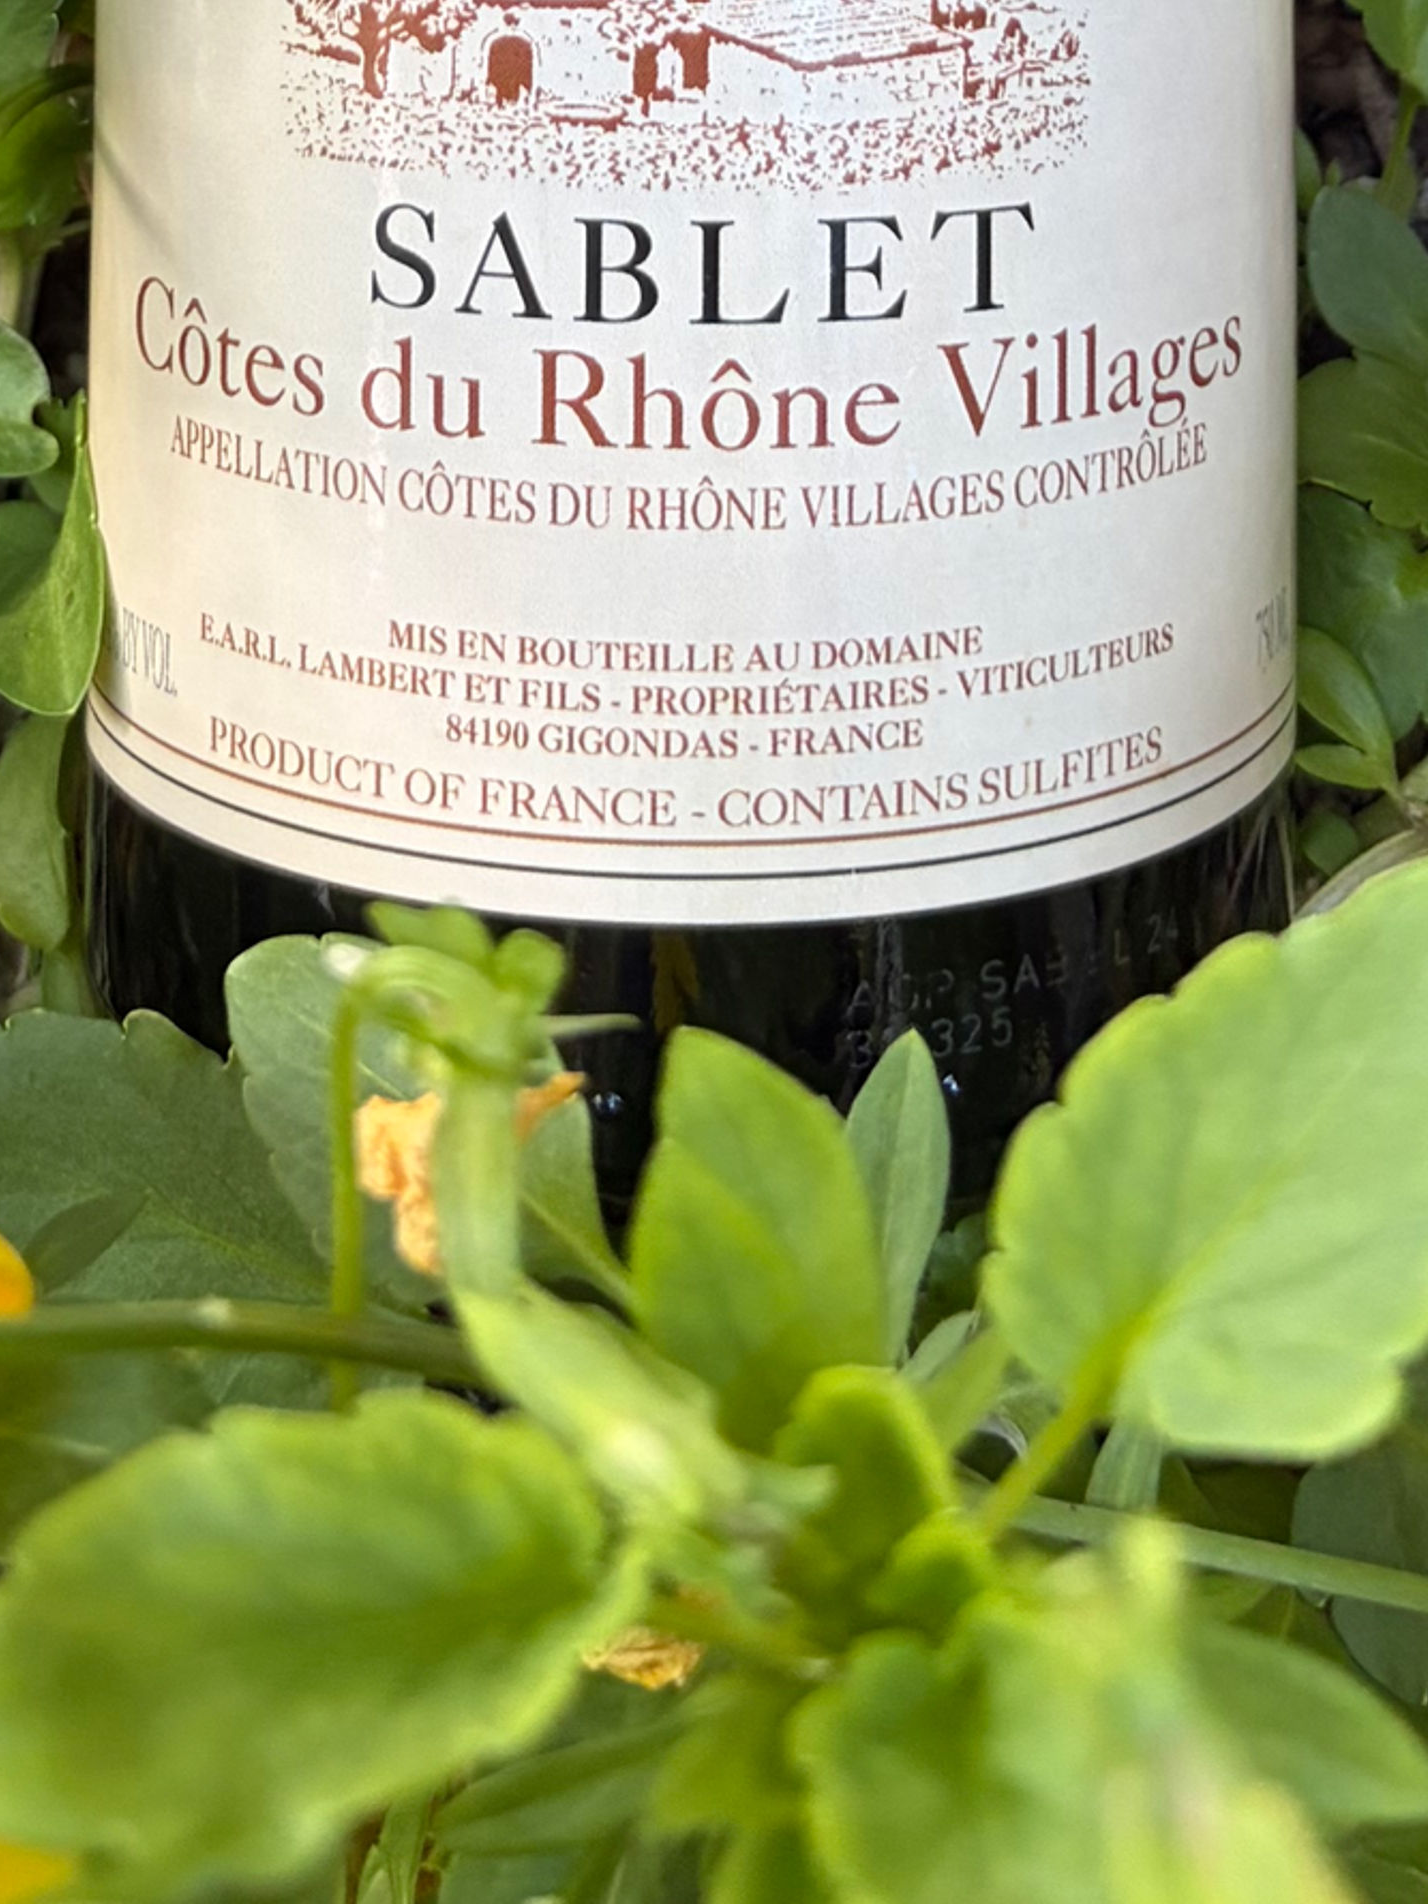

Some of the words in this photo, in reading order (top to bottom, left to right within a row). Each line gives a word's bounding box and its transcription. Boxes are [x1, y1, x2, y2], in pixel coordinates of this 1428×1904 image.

[371, 201, 1036, 325] SABLET
[135, 276, 325, 417] Côtes
[360, 336, 486, 439] du
[532, 348, 902, 452] Rhône
[937, 314, 1243, 437] Villages
[171, 414, 389, 507] APPELLATION
[398, 459, 537, 524] CÔTES
[548, 482, 612, 530] DU
[626, 475, 787, 532] RHÔNE
[801, 469, 1006, 528] VILLAGES
[1013, 417, 1208, 509] CONTRÔLÉE
[198, 612, 292, 668] E.A.R.L.
[298, 644, 457, 702] LAMBERT
[465, 674, 511, 707] ET
[518, 678, 601, 714] FILS
[631, 674, 929, 716] PROPRIÉTAIRES
[955, 622, 1174, 699] VITICULTEURS
[387, 618, 448, 657] MIS
[456, 630, 507, 664] EN
[517, 635, 734, 673] BOUTEILLE
[742, 642, 800, 673] AU
[812, 624, 983, 669] DOMAINE
[209, 714, 396, 798] PRODUCT
[404, 766, 467, 810] OF
[478, 777, 678, 828] FRANCE
[717, 772, 970, 829] CONTAINS
[977, 725, 1164, 808] SULFITES
[445, 714, 530, 751] 84190
[537, 724, 740, 760] GIGONDAS
[767, 717, 924, 759] FRANCE
